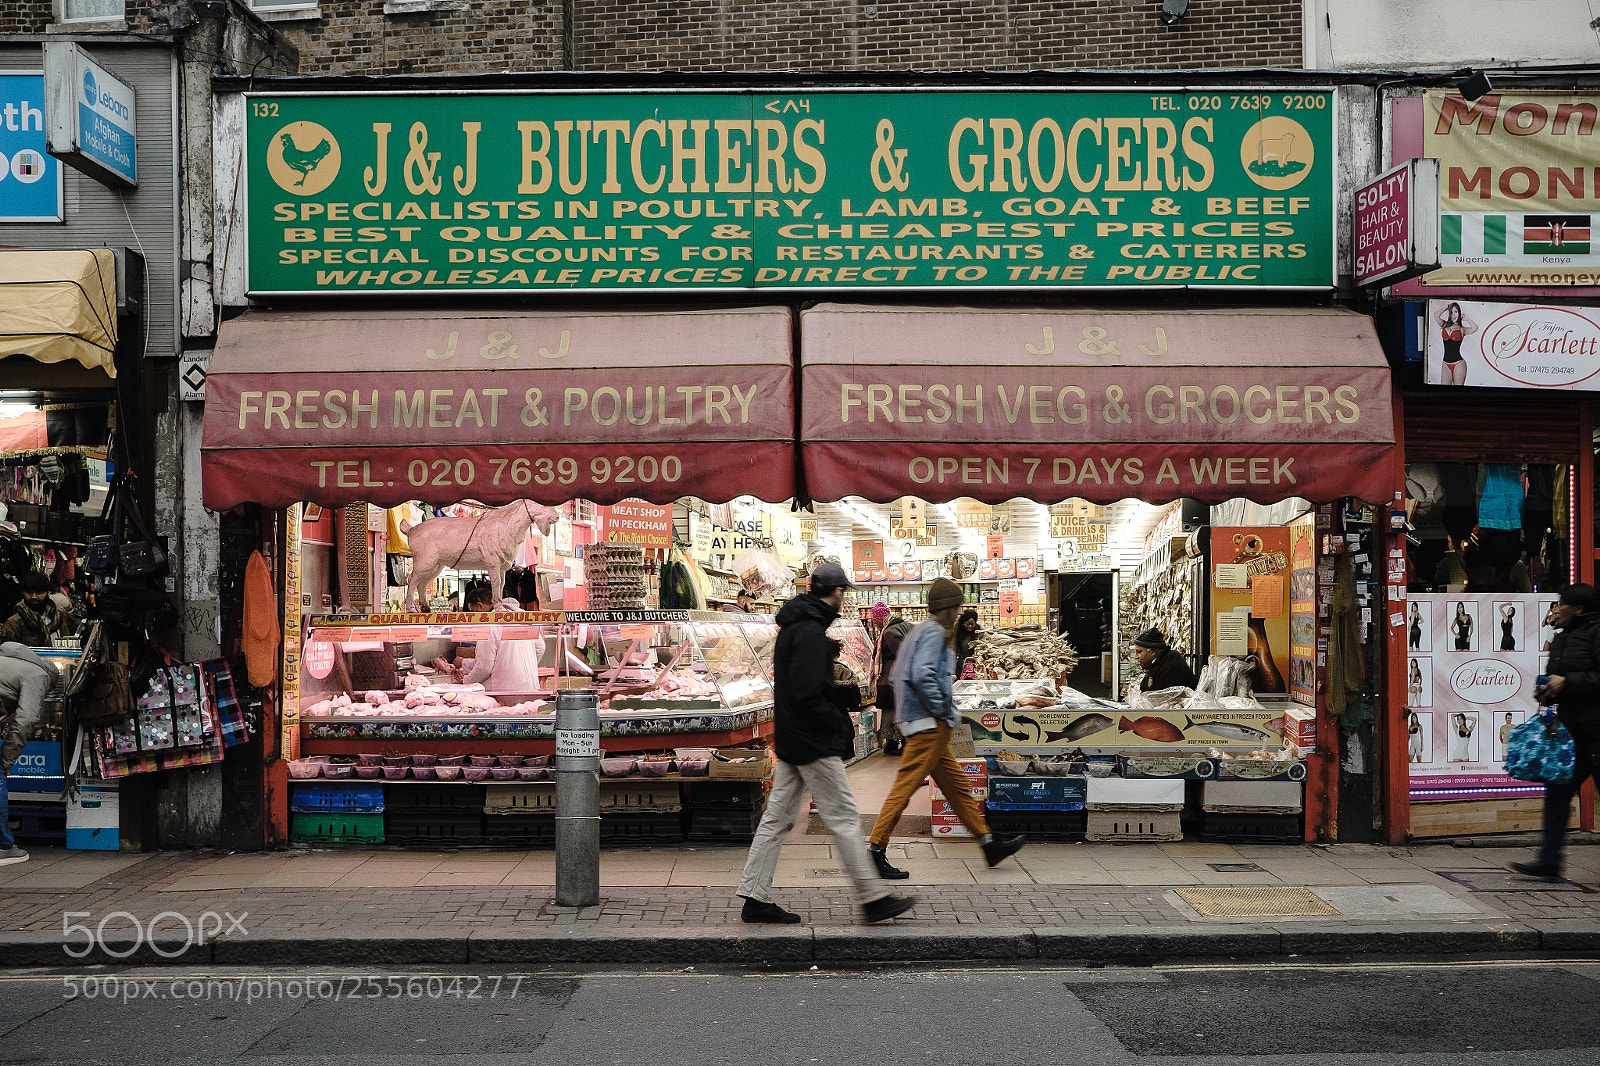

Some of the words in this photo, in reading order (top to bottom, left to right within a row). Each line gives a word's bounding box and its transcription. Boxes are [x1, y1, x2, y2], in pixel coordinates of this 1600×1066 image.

[98, 84, 129, 121] Lebara
[253, 103, 280, 117] 132
[1151, 97, 1181, 111] TEL.
[1188, 97, 1222, 111] 020
[1231, 97, 1272, 111] 7639
[1283, 96, 1326, 110] 9200
[0, 100, 43, 132] th
[94, 117, 121, 146] Afghan
[85, 130, 107, 154] Mobile
[108, 144, 113, 158] &
[113, 148, 131, 169] Cloth
[363, 122, 392, 197] J
[403, 121, 442, 196] &
[452, 121, 482, 196] J
[517, 118, 827, 195] BUTCHERS
[871, 118, 910, 193] &
[949, 116, 1215, 193] GROCERS
[1358, 171, 1407, 211] SOLTY
[1448, 166, 1600, 200] MON
[273, 200, 541, 221] SPECIALISTS
[554, 200, 598, 219] IN
[612, 198, 824, 220] POULTRY,
[841, 198, 974, 218] LAMB,
[1002, 197, 1125, 216] GOAT
[1150, 197, 1181, 216] &
[1207, 196, 1310, 216] BEEF
[1361, 205, 1388, 231] HAIR
[1390, 201, 1400, 218] &
[284, 226, 422, 243] BEST
[439, 224, 693, 243] QUALITY
[710, 224, 752, 240] &
[778, 222, 1076, 239] CHEAPEST
[1096, 221, 1295, 237] PRICES
[1359, 217, 1404, 250] BEAUTY
[278, 248, 429, 265] SPECIAL
[448, 246, 660, 264] DISCOUNTS
[681, 245, 753, 261] FOR
[776, 244, 1044, 261] RESTAURANTS
[1068, 244, 1095, 260] &
[1120, 243, 1307, 259] CATERERS
[1356, 238, 1408, 277] SALON
[1455, 256, 1490, 265] Nigeria
[1542, 256, 1571, 264] Kenya
[316, 268, 584, 285] WHOLESALE
[590, 267, 744, 283] PRICES
[754, 266, 917, 282] DIRECT
[932, 265, 988, 281] TO
[1006, 265, 1088, 281] THE
[1105, 264, 1261, 280] PUBLIC
[425, 330, 460, 360] J
[478, 329, 521, 360] &
[537, 329, 572, 360] J
[1025, 325, 1057, 356] J
[1077, 325, 1123, 356] &
[1137, 326, 1169, 356] J
[1491, 320, 1598, 367] Scarlett
[1517, 365, 1529, 373] Tel:
[1530, 366, 1550, 374] 07475
[237, 388, 379, 430] FRESH
[393, 386, 508, 429] MEAT
[520, 385, 550, 428] &
[563, 383, 758, 427] POULTRY
[840, 382, 985, 424] FRESH
[997, 383, 1090, 424] VEG
[1101, 383, 1133, 424] &
[1143, 382, 1363, 425] GROCERS
[310, 459, 395, 489] TEL:
[406, 458, 476, 487] 020
[488, 456, 579, 486] 7639
[590, 454, 683, 484] 9200
[907, 456, 1012, 486] OPEN
[1020, 457, 1043, 486] 7
[1052, 456, 1145, 486] DAYS
[1154, 456, 1182, 486] A
[1190, 456, 1298, 486] WEEK
[611, 505, 639, 516] MEAT
[640, 507, 666, 518] SHOP
[1054, 516, 1086, 526] JUICE
[609, 519, 619, 528] IN
[622, 520, 668, 531] PECKHAM
[894, 528, 923, 538] OIL
[1053, 527, 1058, 536] &
[1099, 524, 1105, 533] &
[620, 532, 631, 542] The
[904, 542, 912, 557] 2
[1065, 541, 1074, 557] 3
[370, 613, 433, 625] QUALITY
[436, 613, 476, 624] MEAT
[479, 613, 490, 623] &
[494, 611, 561, 623] POULTRY
[566, 612, 610, 622] WELCOME
[612, 611, 624, 621] TO
[625, 611, 643, 621] J&J
[644, 610, 689, 621] BUTCHERS
[1456, 666, 1515, 690] Scarlett
[18, 766, 46, 774] mobile
